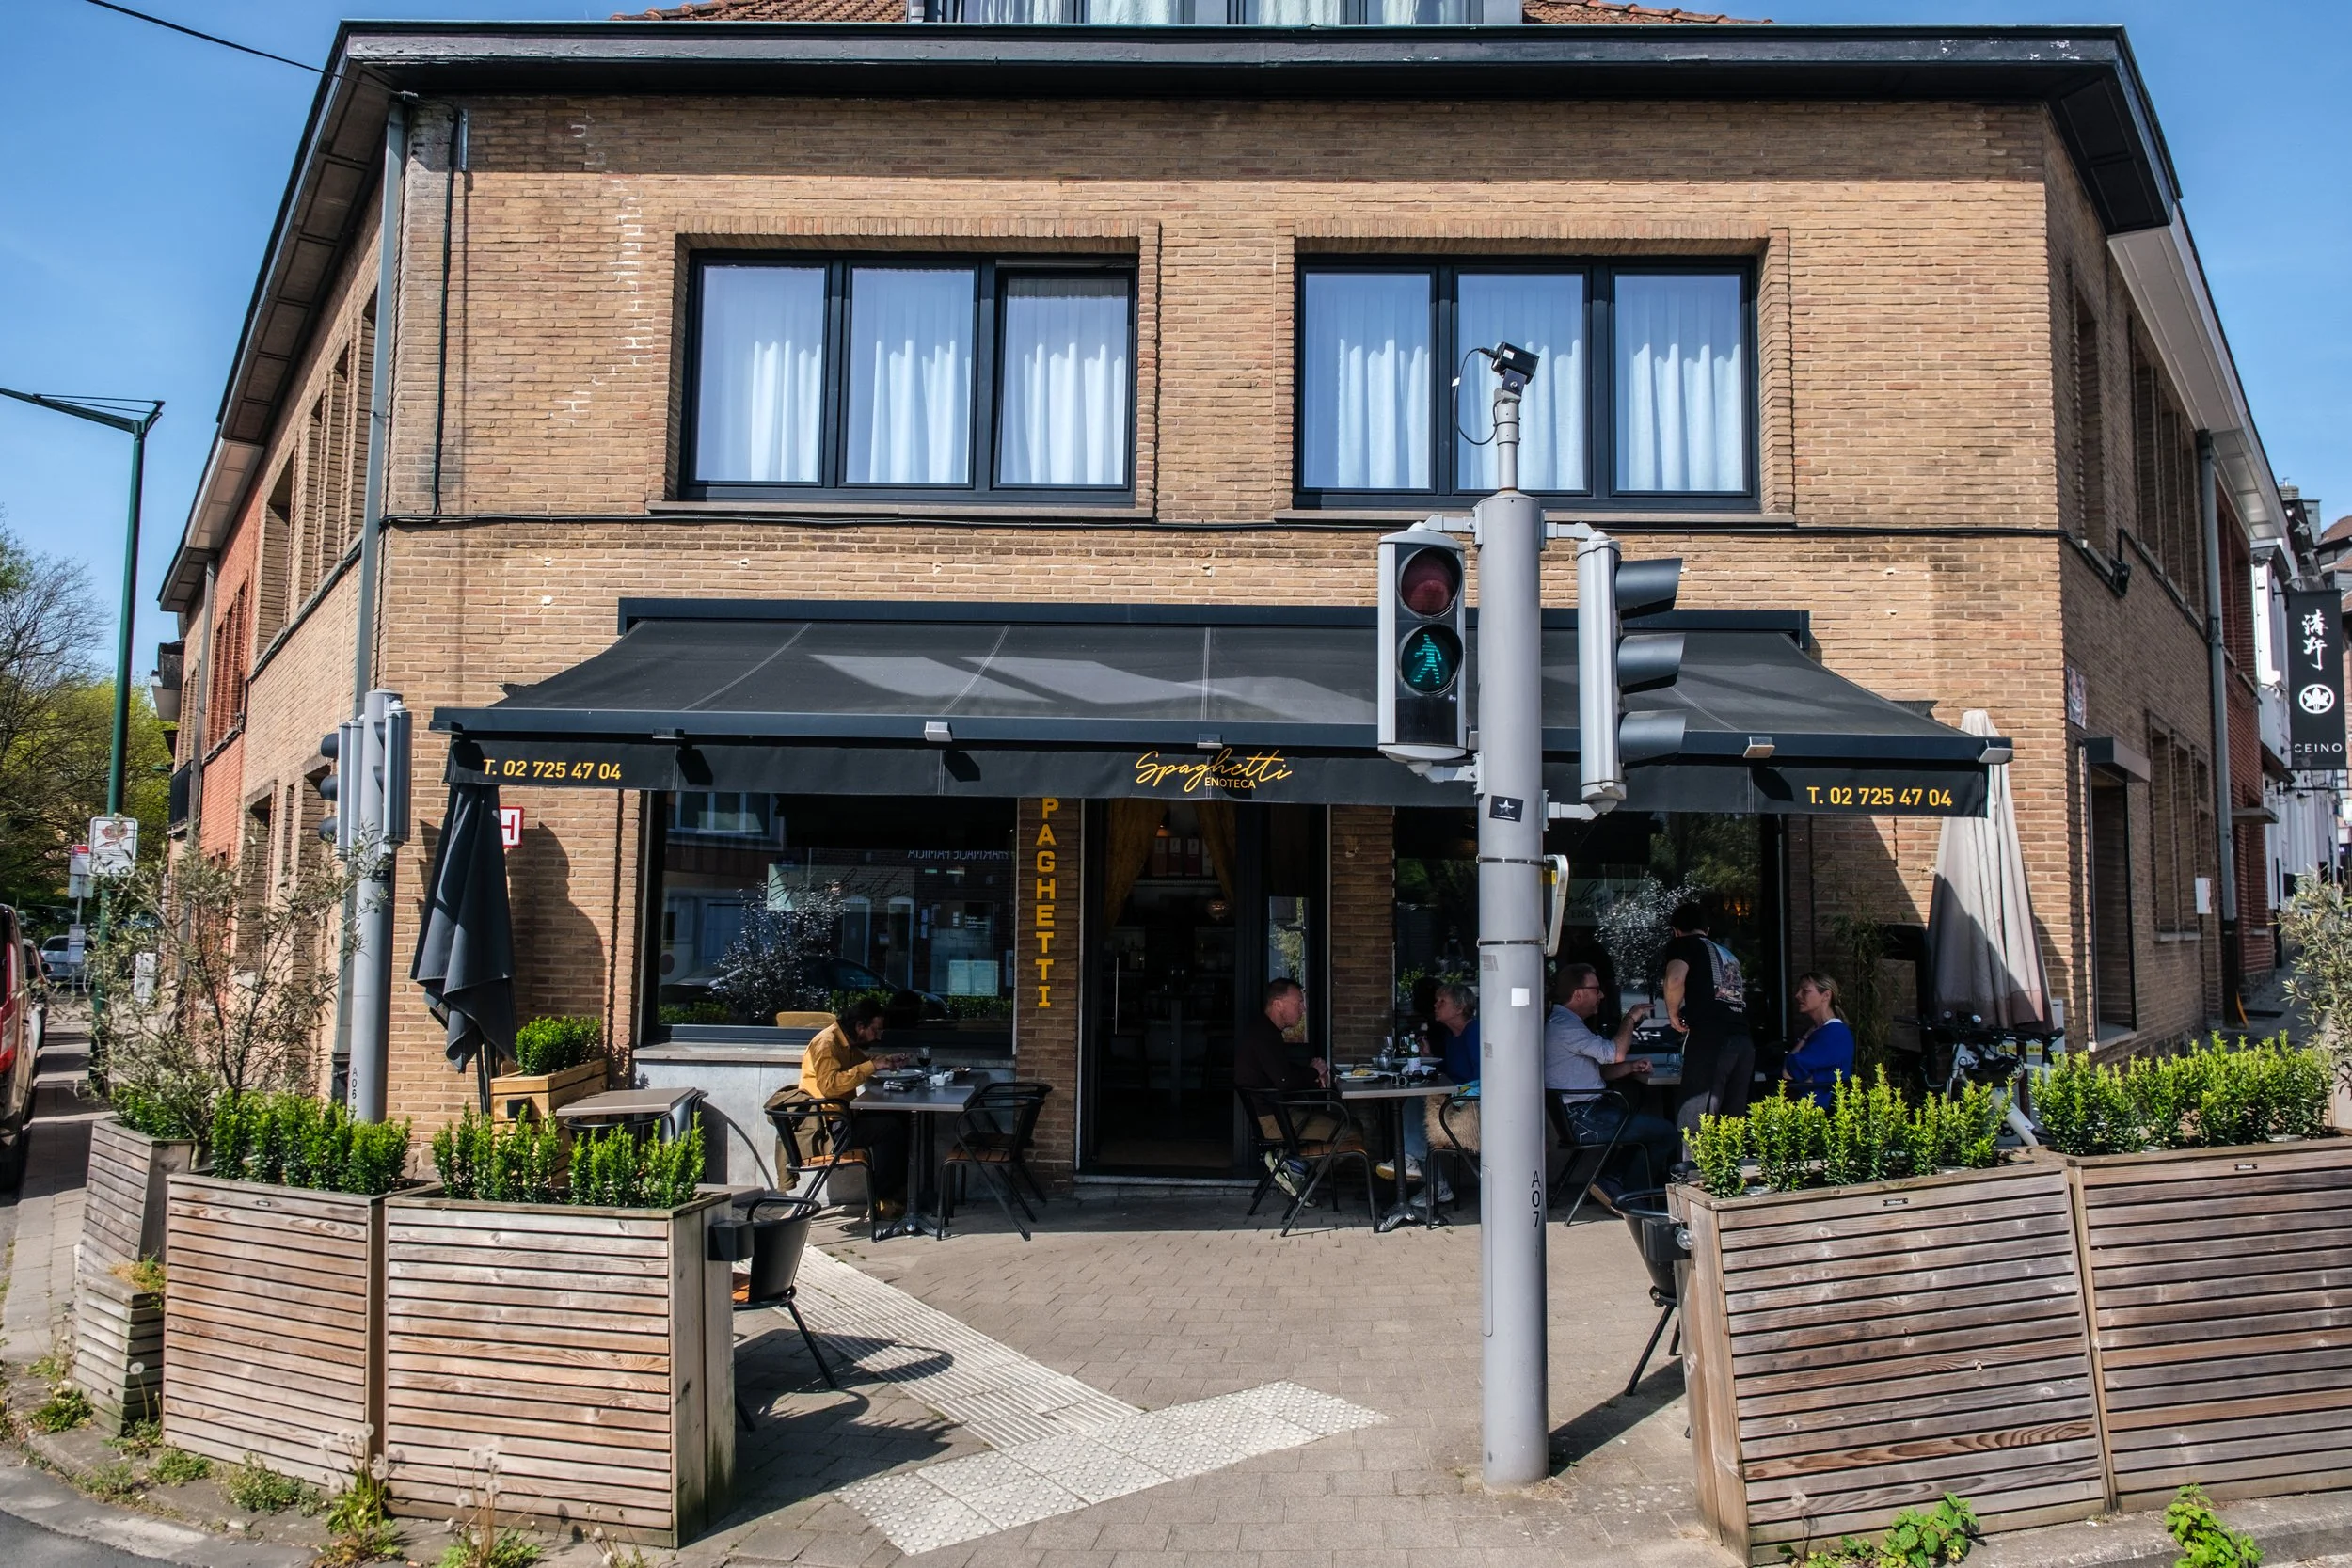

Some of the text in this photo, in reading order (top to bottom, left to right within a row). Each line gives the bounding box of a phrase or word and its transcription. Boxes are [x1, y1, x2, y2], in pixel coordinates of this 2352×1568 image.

[2294, 743, 2343, 753] CEINO
[483, 759, 622, 781] T. 02 725 47 04
[1136, 748, 1293, 793] Spaghetti
[1204, 778, 1257, 789] ENOTECA
[1806, 786, 1952, 806] T. 02 725 47 04
[1531, 1170, 1541, 1227] A07
